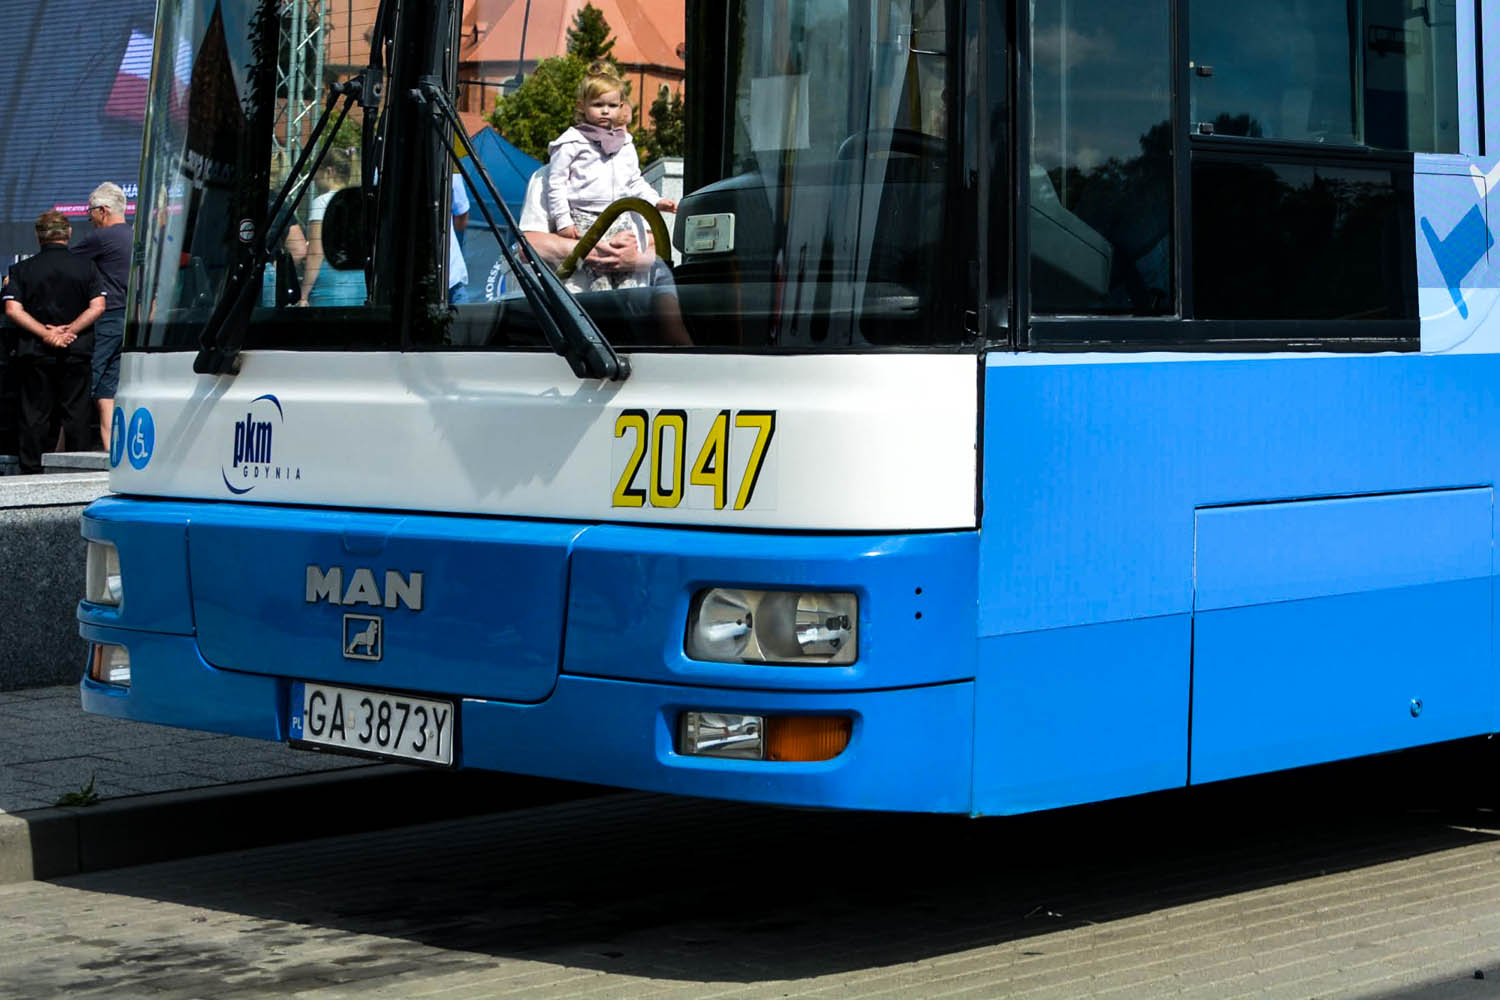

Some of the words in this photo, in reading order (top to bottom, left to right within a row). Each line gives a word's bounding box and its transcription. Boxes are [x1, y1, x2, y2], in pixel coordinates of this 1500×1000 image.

[233, 412, 273, 469] pkm
[612, 408, 778, 512] 2047
[243, 465, 302, 481] GDYNIA
[305, 564, 425, 611] MAN
[292, 716, 303, 730] PL
[307, 690, 347, 742] GA
[357, 698, 448, 757] 3873Y
